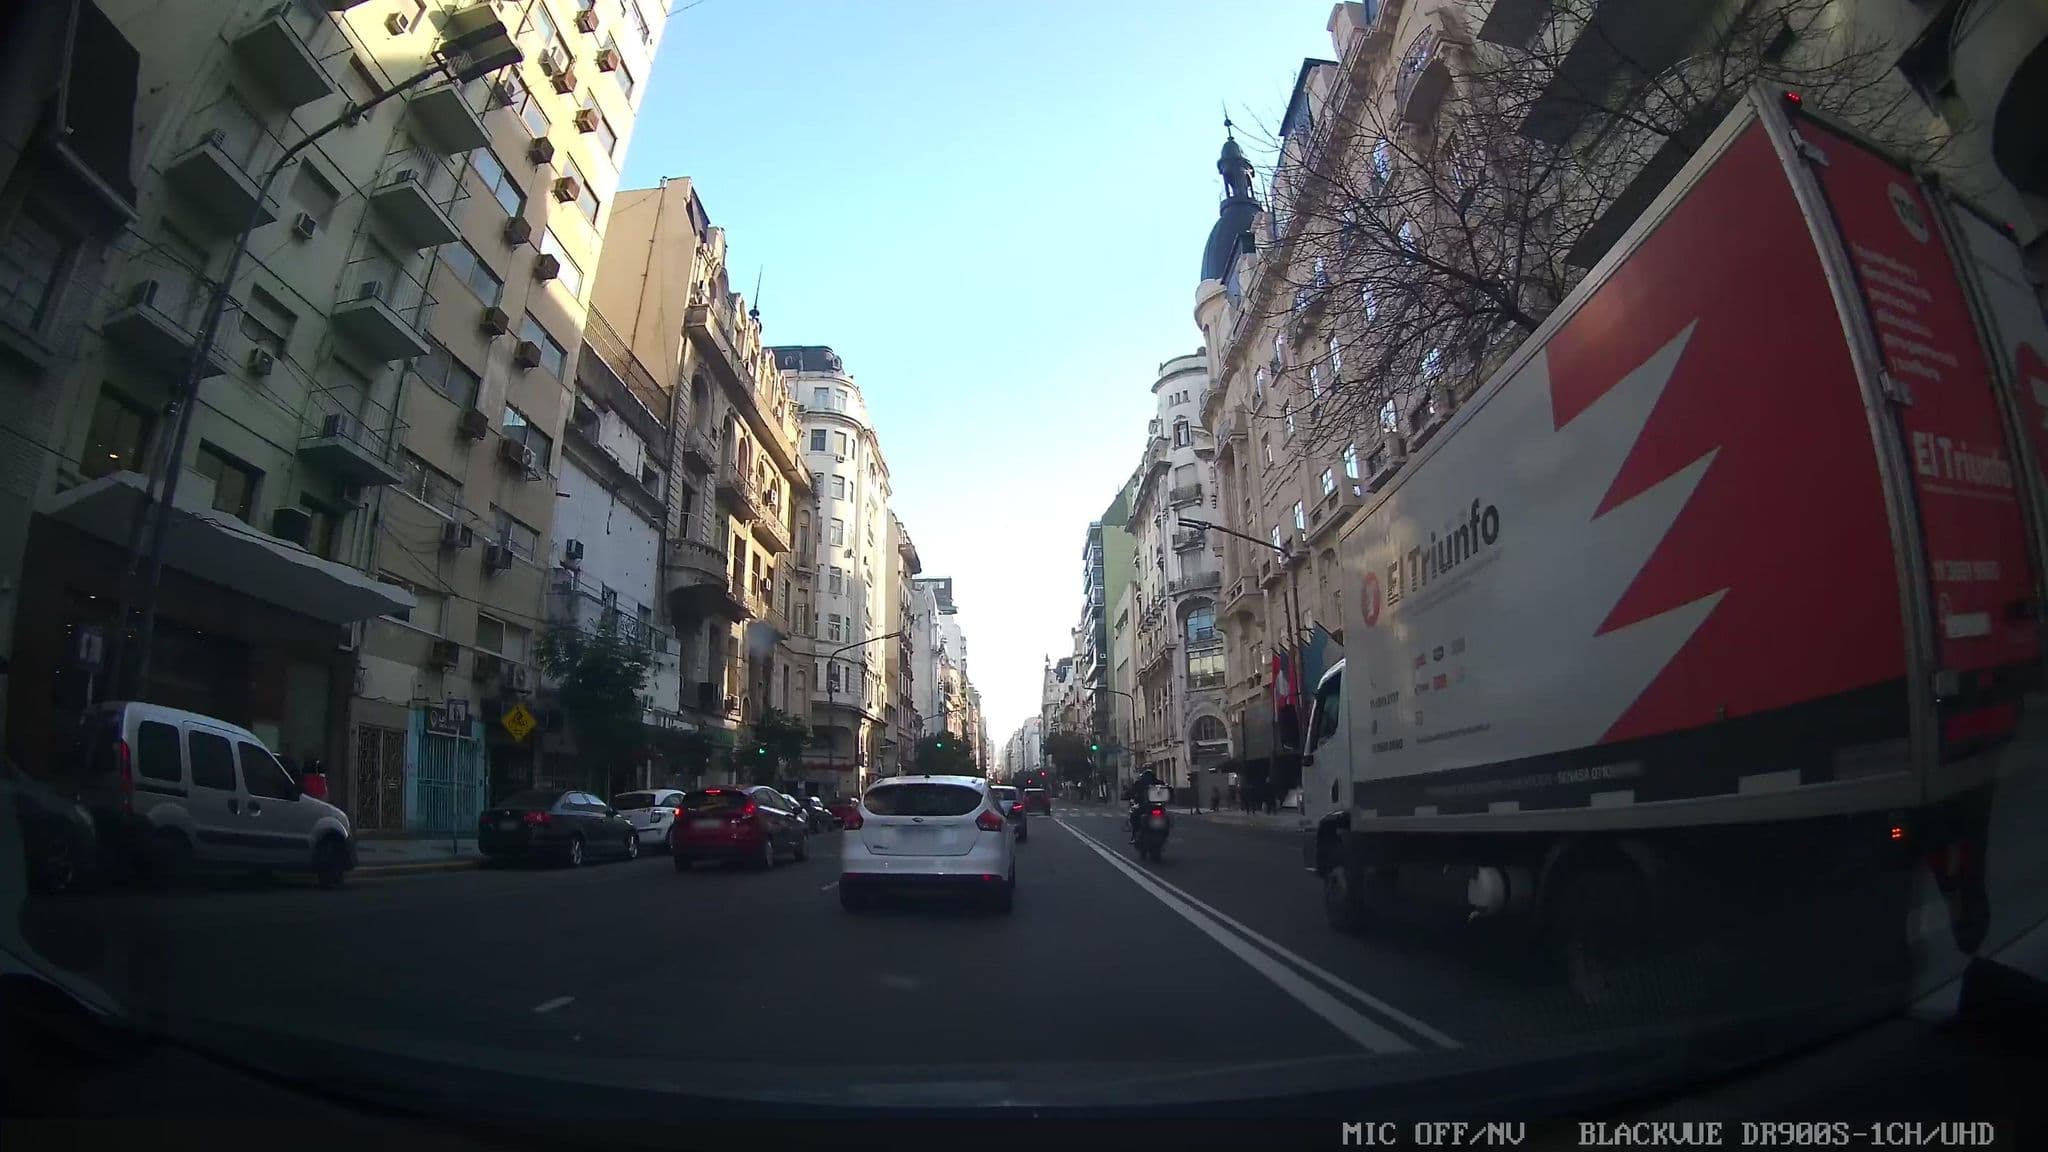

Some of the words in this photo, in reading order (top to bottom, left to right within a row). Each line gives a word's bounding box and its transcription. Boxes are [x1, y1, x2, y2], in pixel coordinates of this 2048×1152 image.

[1912, 431, 1939, 477] El
[1387, 554, 1405, 606] El
[1408, 497, 1500, 592] Triunfo
